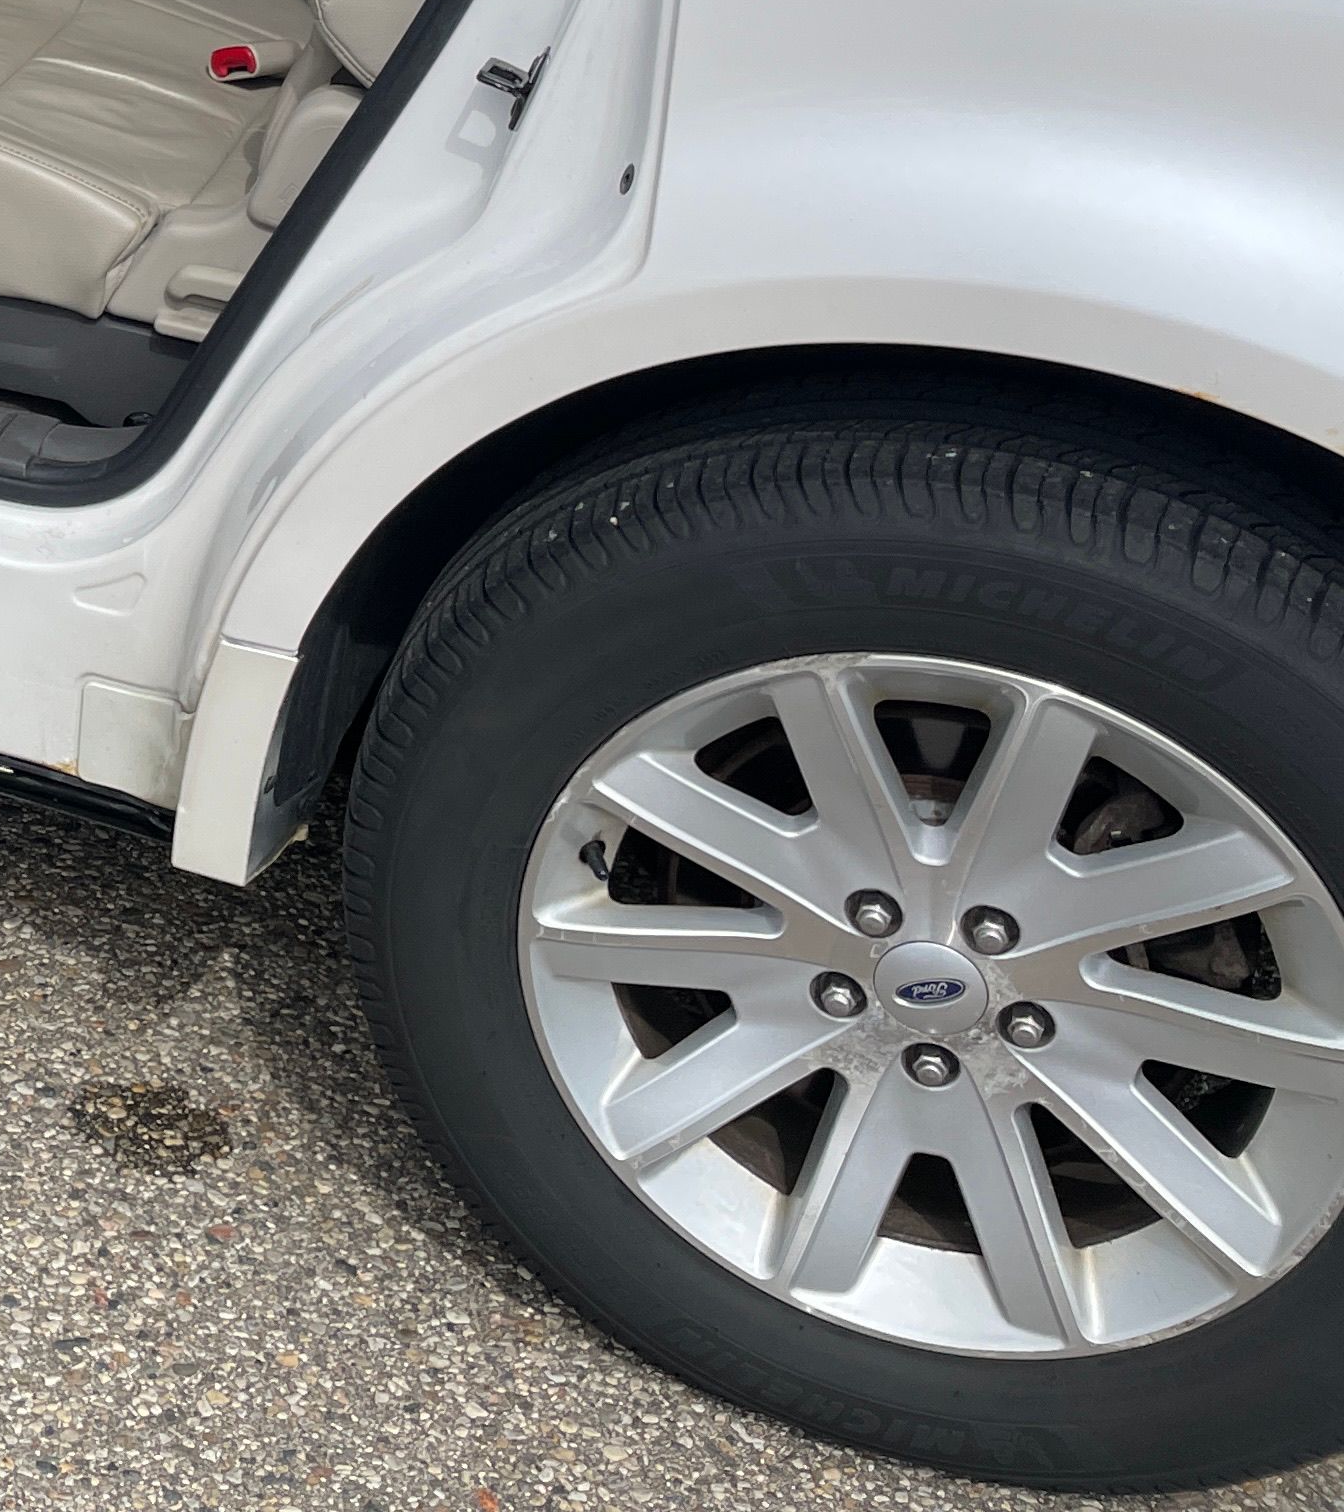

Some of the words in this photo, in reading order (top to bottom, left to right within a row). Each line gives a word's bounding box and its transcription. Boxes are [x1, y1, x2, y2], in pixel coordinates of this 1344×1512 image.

[886, 566, 1226, 681] MICHELIN
[912, 983, 948, 999] Ford
[669, 1327, 965, 1456] MICHELIN
